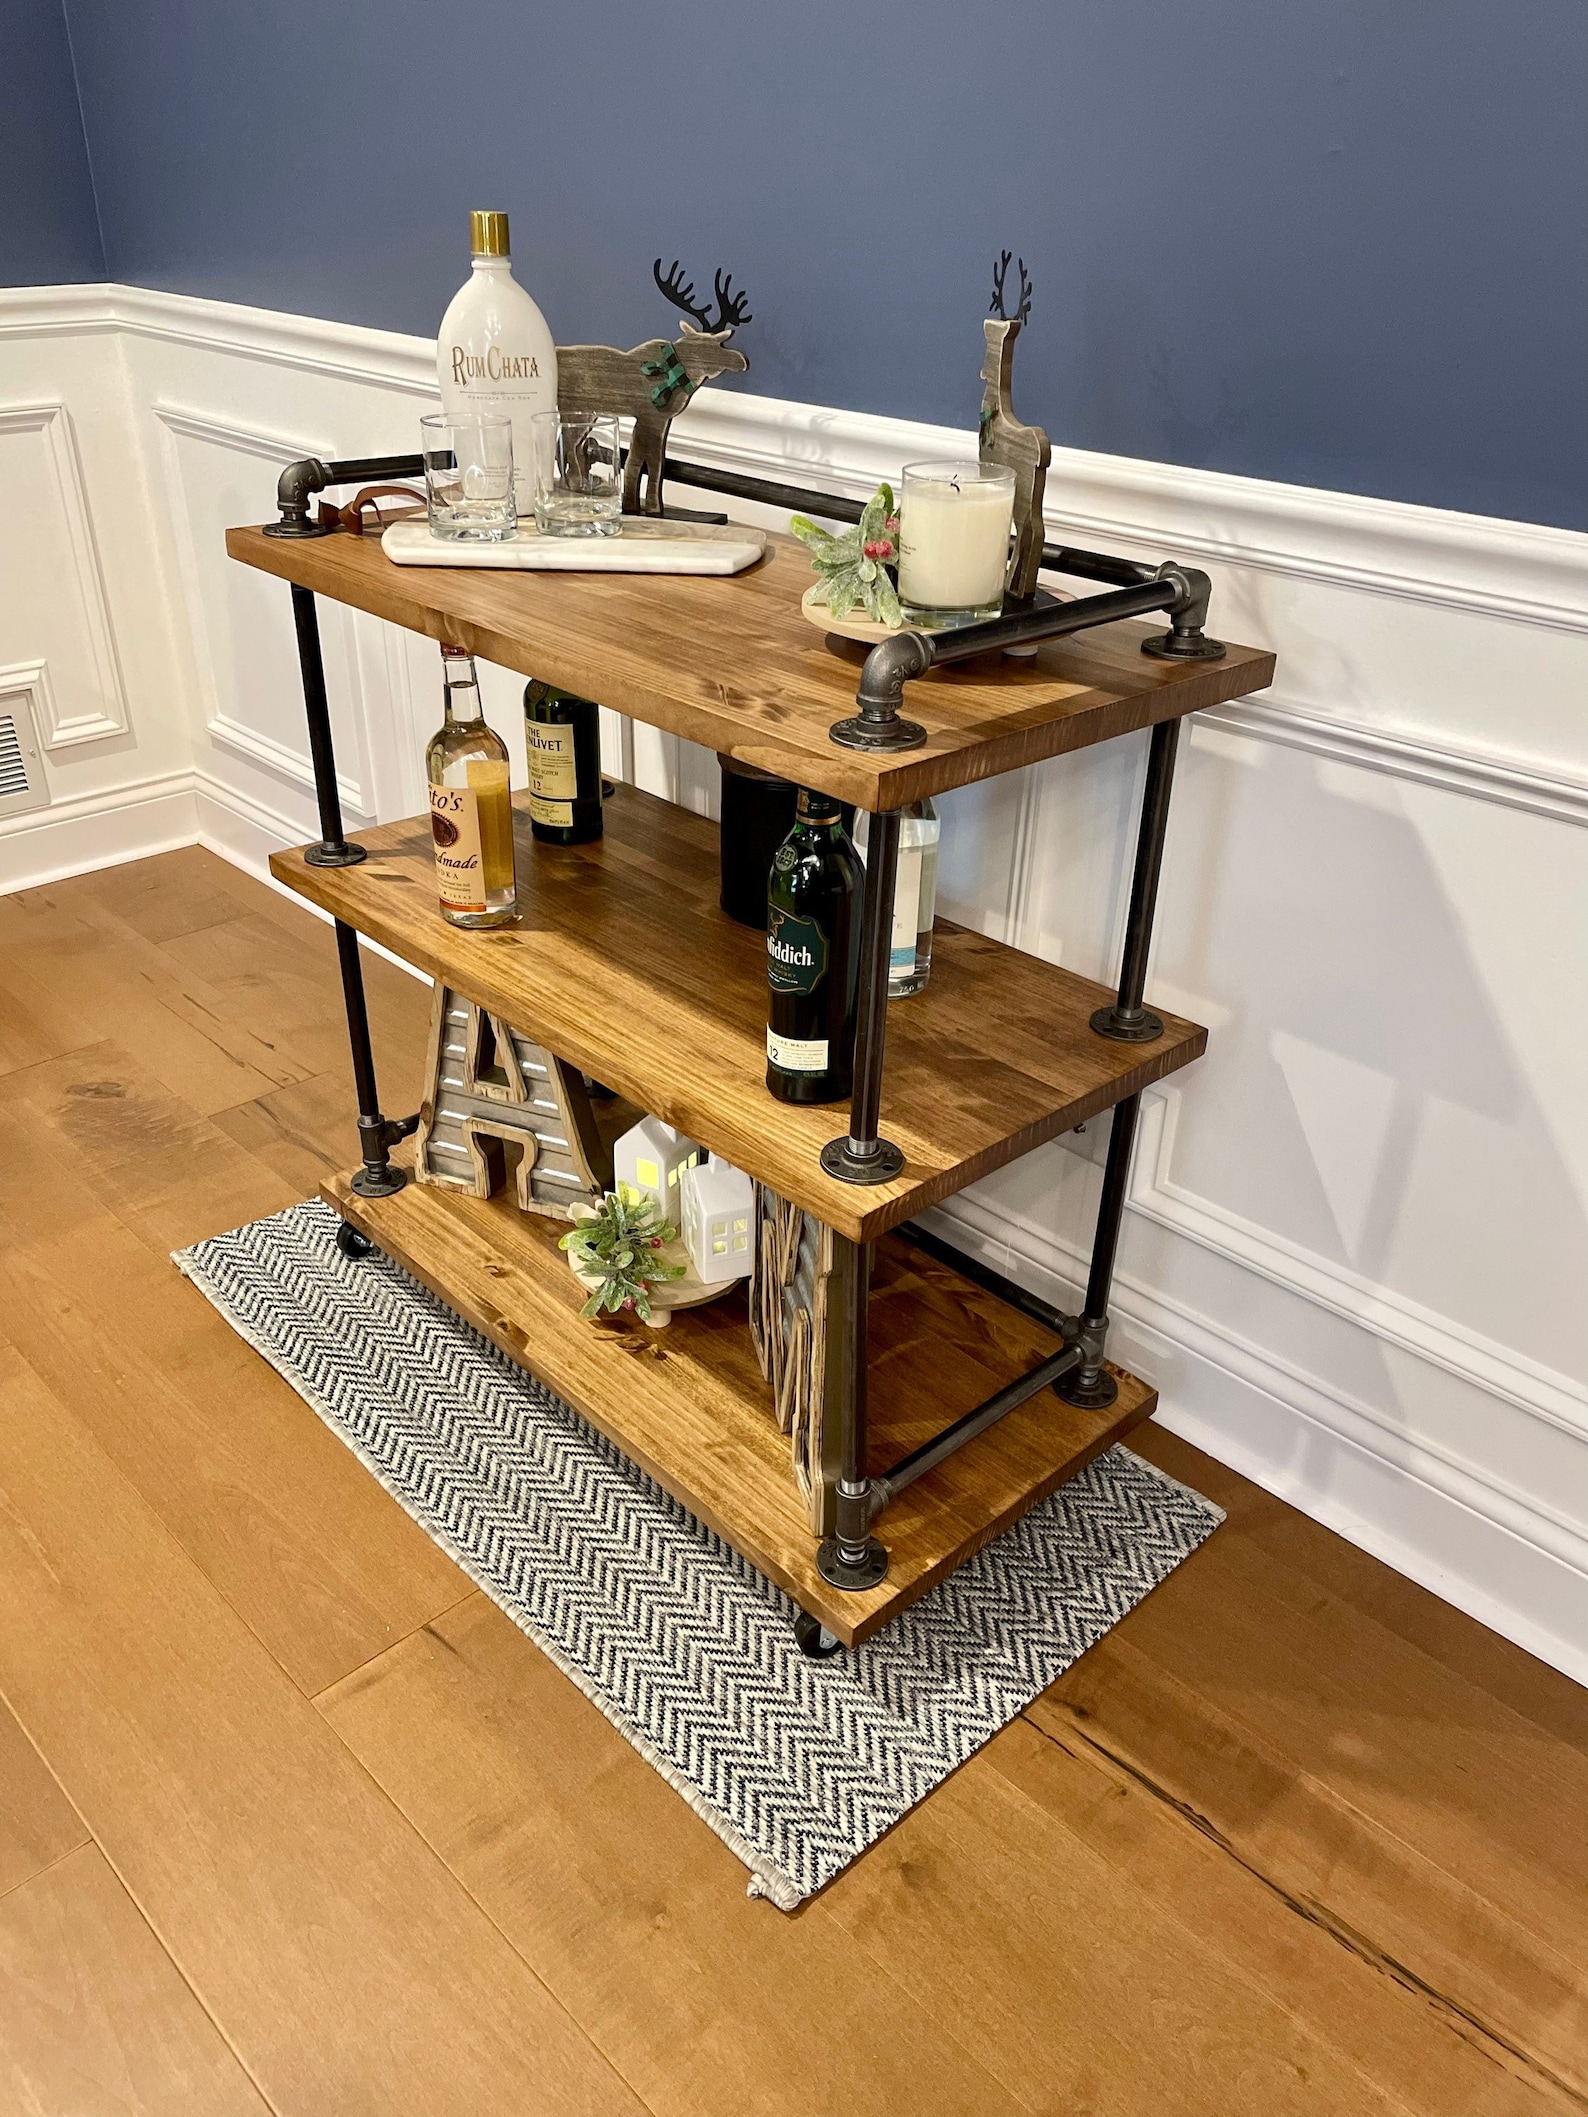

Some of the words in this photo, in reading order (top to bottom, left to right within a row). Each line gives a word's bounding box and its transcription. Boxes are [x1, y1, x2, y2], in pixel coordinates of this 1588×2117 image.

[528, 726, 541, 738] THE
[533, 780, 541, 790] 12
[769, 1045, 779, 1061] 12
